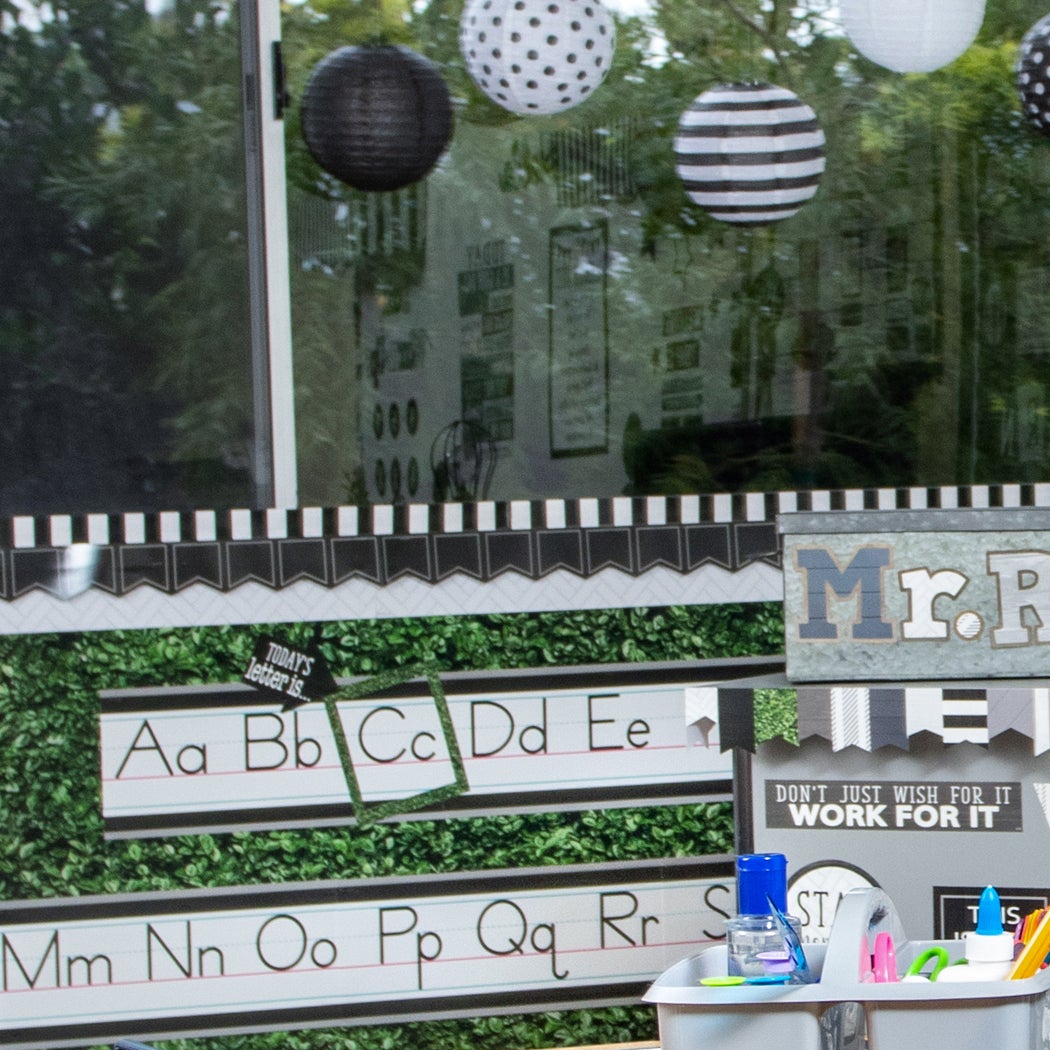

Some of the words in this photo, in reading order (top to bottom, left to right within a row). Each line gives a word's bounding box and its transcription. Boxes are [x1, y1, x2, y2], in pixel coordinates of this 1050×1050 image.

[244, 656, 289, 692] letter
[265, 641, 316, 677] TODAY'S
[116, 720, 207, 779] Aa
[244, 711, 323, 771] Bb
[358, 706, 437, 763] Cc
[470, 698, 547, 758] Dd
[587, 693, 651, 752] Ee
[775, 784, 828, 804] DON'T
[839, 785, 882, 804] JUST
[893, 785, 938, 805] WISH
[950, 786, 984, 805] FOR
[994, 786, 1012, 805] IT
[788, 803, 888, 827] WORK
[896, 805, 960, 828] FOR
[969, 805, 1000, 828] IT
[797, 890, 844, 928] ST
[967, 905, 1021, 925] TIS
[2, 929, 112, 992] Mm
[146, 920, 225, 979] Nn
[256, 913, 338, 972] Oo
[379, 906, 442, 990] Pp
[477, 899, 570, 980] Qq
[600, 891, 660, 950] Rr
